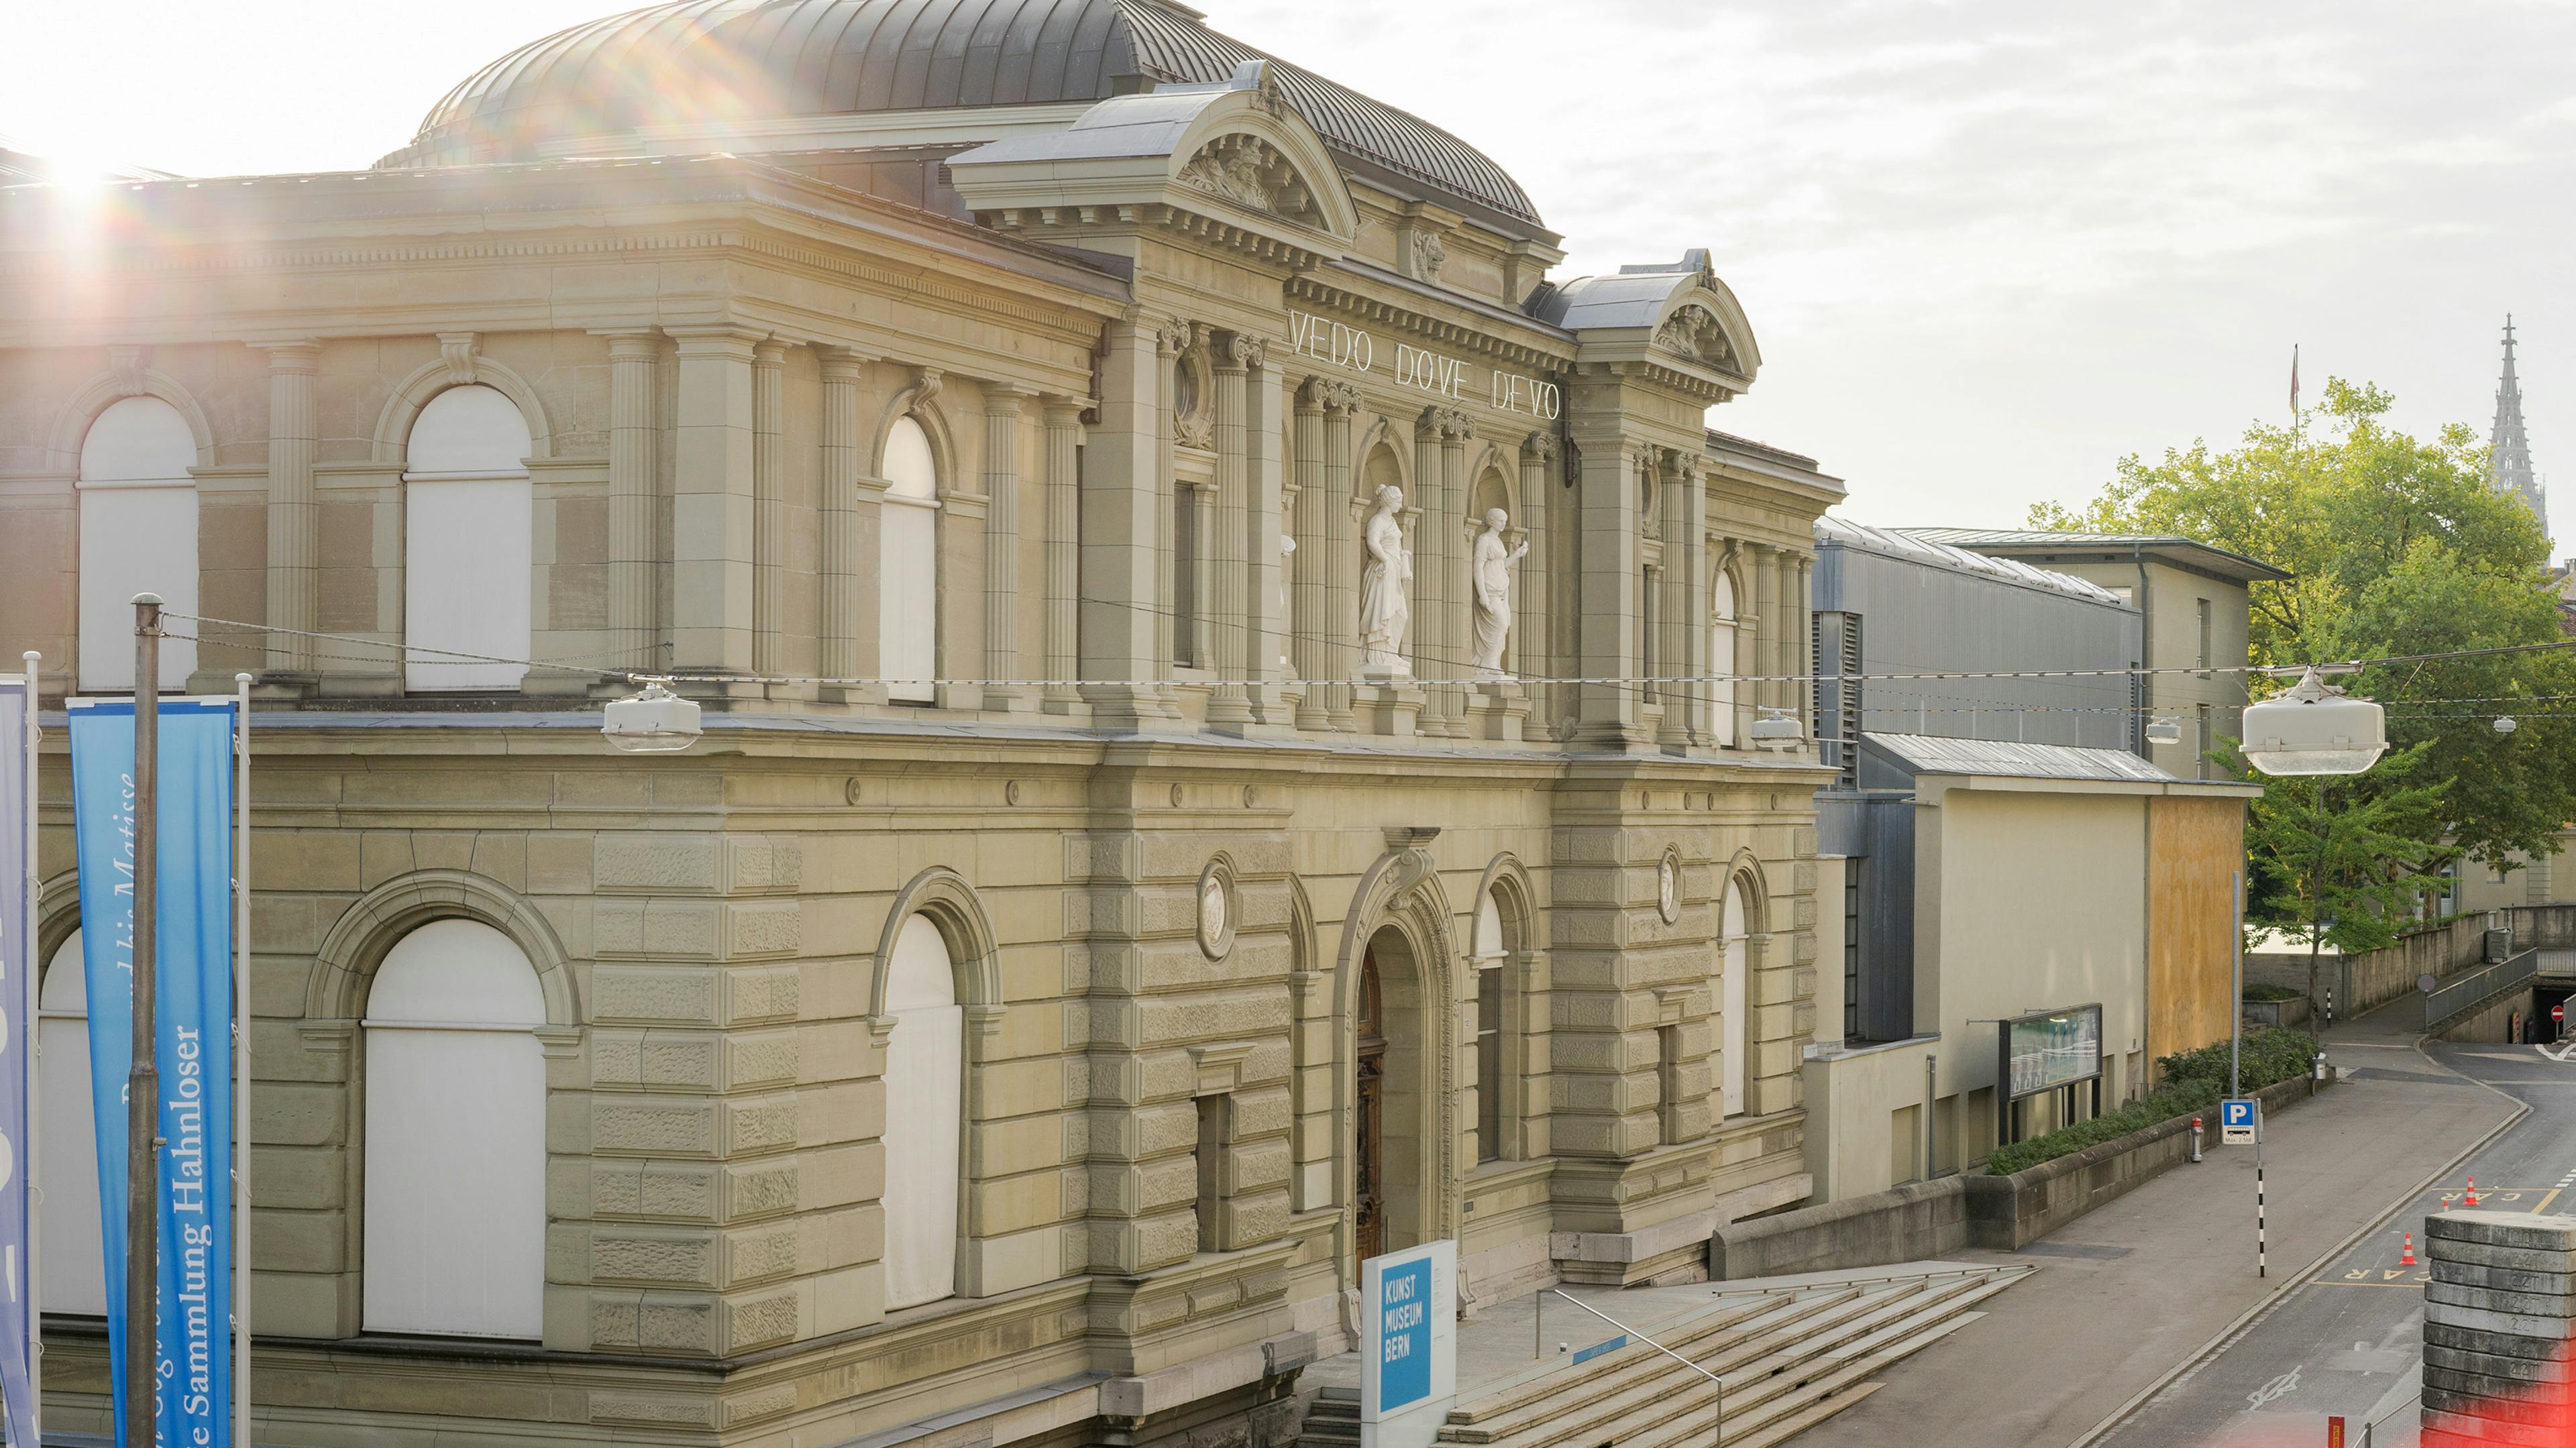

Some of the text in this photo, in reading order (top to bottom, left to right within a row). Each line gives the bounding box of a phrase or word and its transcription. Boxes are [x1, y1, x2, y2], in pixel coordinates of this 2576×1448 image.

[1290, 309, 1560, 421] VEDO DOVE DEVO
[168, 1025, 203, 1215] Hahnloser
[2231, 1105, 2247, 1124] P
[1385, 1274, 1416, 1305] KUNST
[2511, 1273, 2539, 1290] 2.2T
[178, 1224, 212, 1417] Sammlung
[1385, 1301, 1422, 1334] MUSEUM
[1385, 1333, 1410, 1363] BERN
